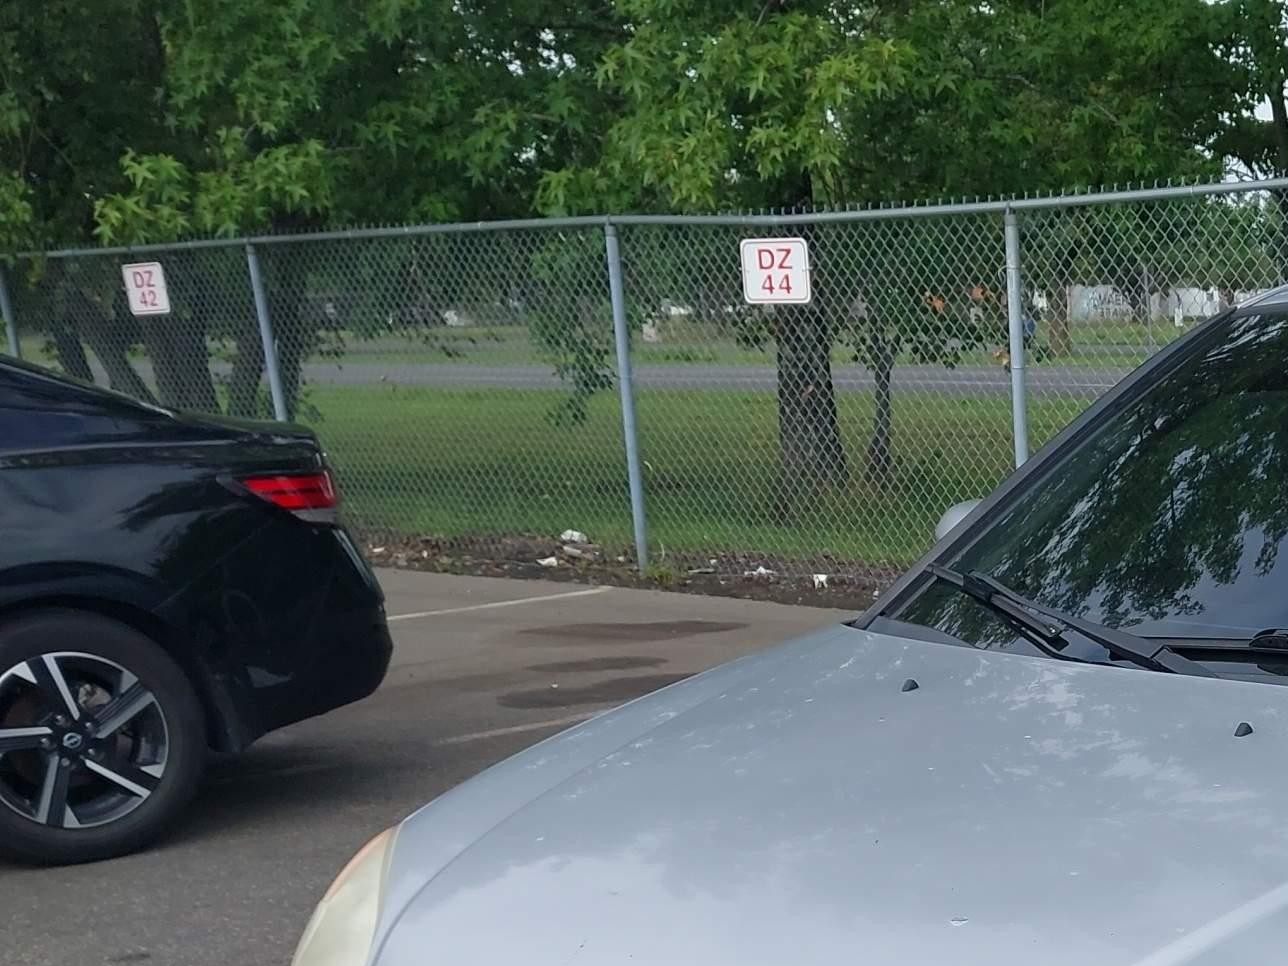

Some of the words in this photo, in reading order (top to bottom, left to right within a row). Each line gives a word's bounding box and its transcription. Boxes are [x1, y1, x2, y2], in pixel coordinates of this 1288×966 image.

[757, 248, 793, 270] DZ
[132, 270, 156, 289] DZ
[761, 273, 793, 295] 44
[139, 290, 159, 308] 42
